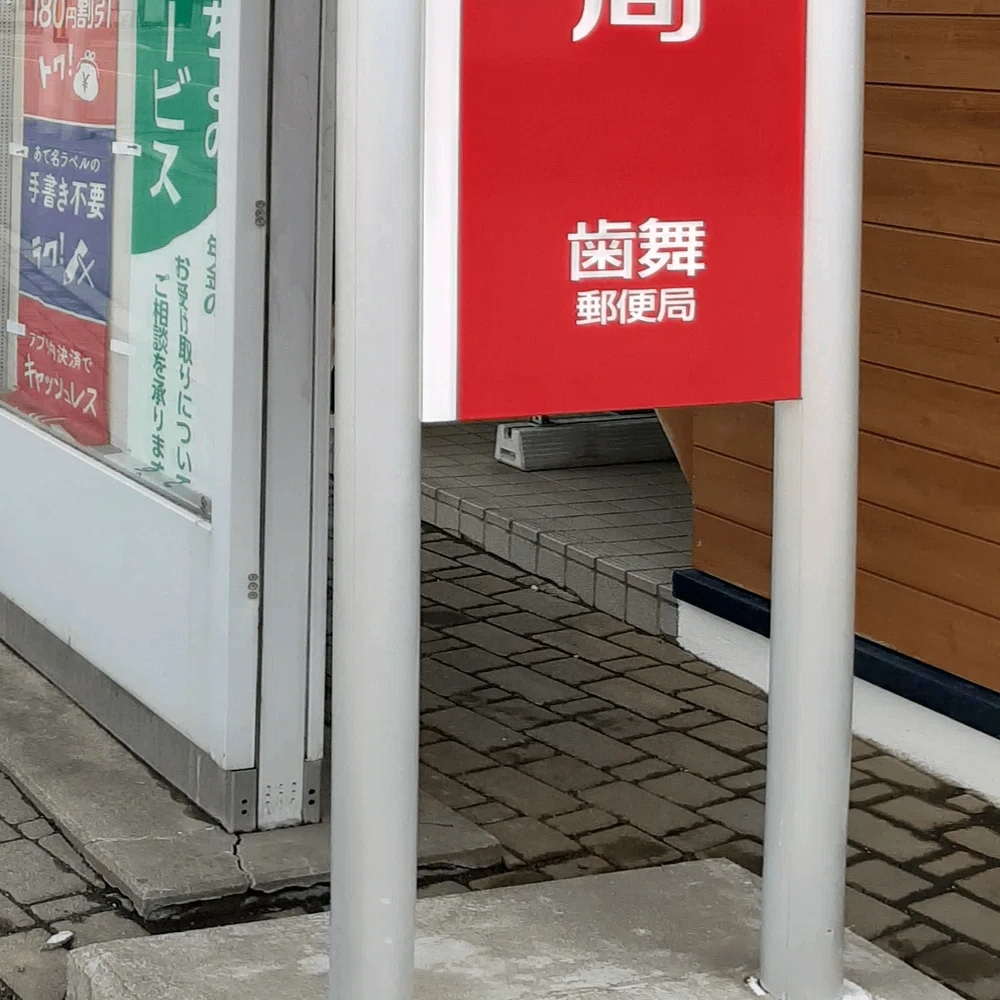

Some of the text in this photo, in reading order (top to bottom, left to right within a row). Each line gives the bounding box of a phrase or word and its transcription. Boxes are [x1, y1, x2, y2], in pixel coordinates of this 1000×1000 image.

[33, 145, 100, 173] あて名ラベルの
[28, 171, 107, 220] 手書き不要
[567, 217, 706, 282] 歯舞
[575, 287, 696, 325] 郵便局
[24, 353, 97, 418] キャッシュレス
